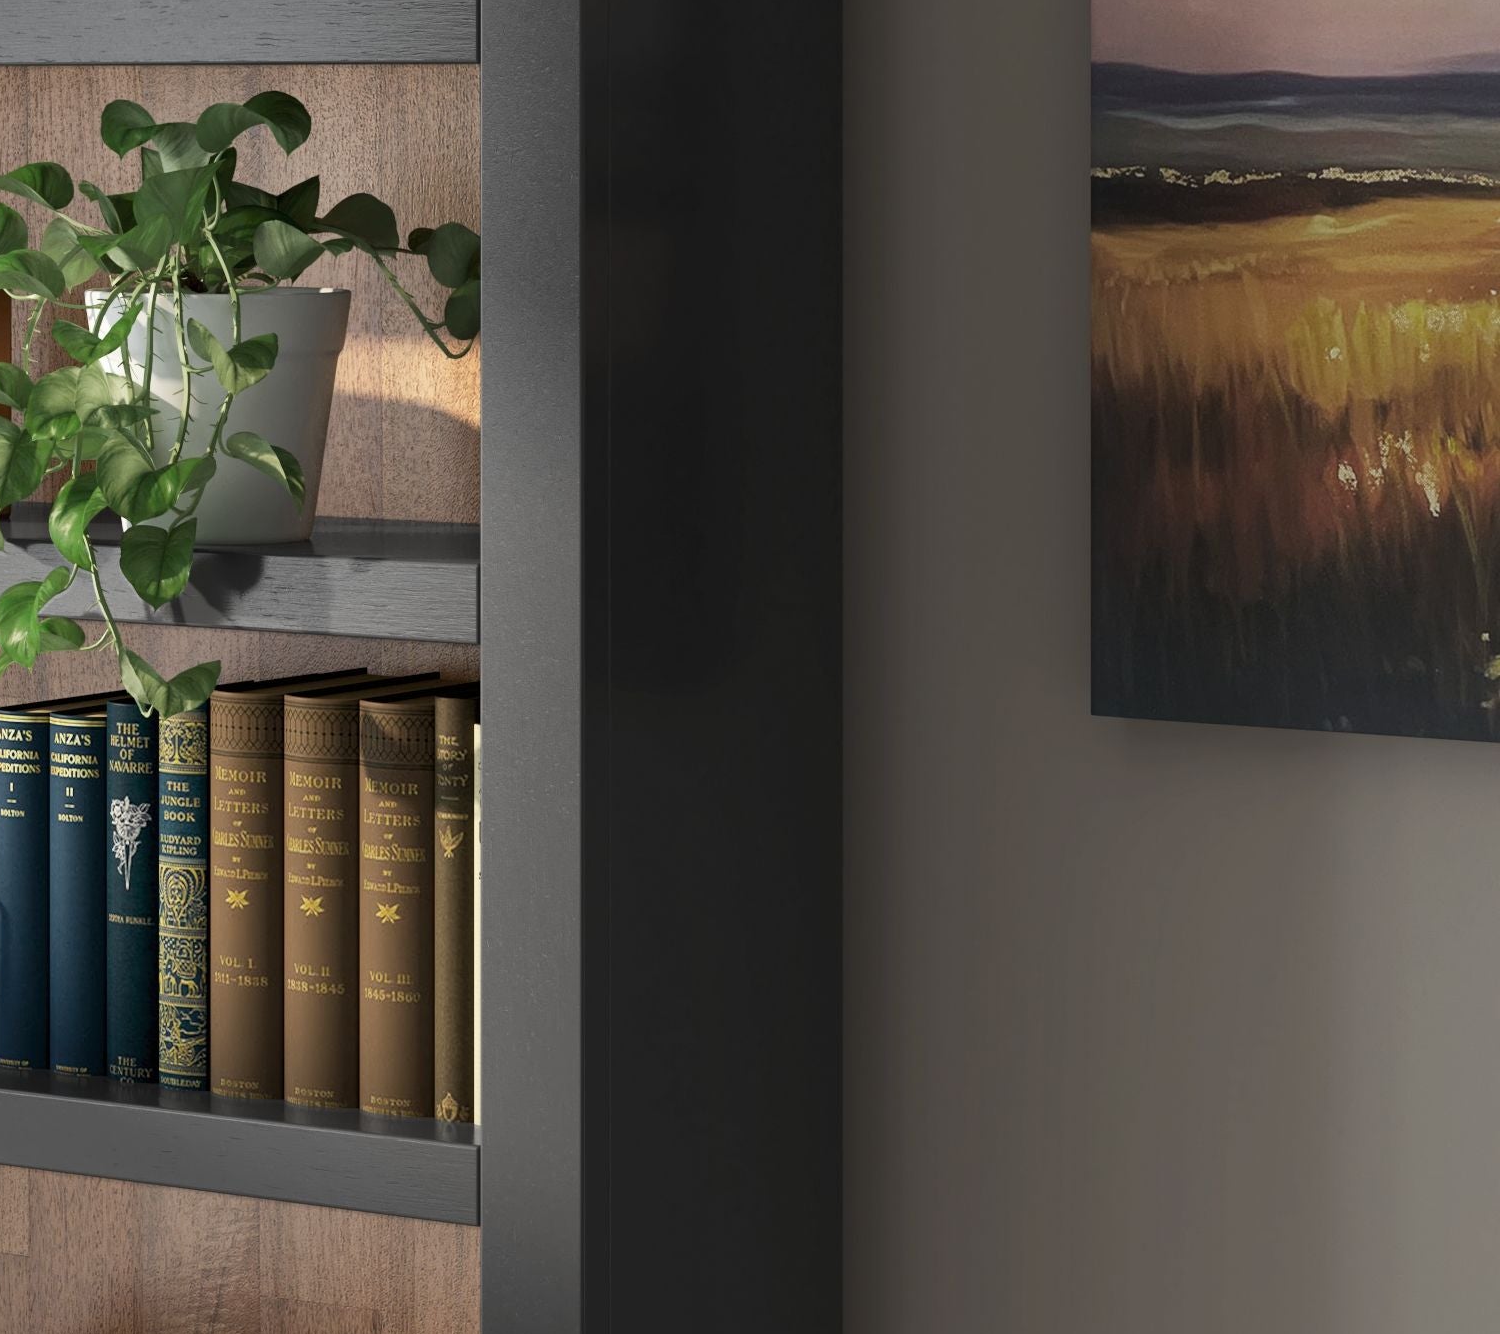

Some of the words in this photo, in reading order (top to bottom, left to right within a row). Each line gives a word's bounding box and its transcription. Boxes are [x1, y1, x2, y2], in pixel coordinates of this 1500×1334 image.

[116, 722, 140, 736] THE
[54, 732, 91, 747] ANZA'S
[110, 735, 150, 749] HELMET
[439, 734, 459, 746] THE
[51, 752, 98, 765] CALIFORNIA
[120, 749, 134, 760] OF
[437, 748, 467, 761] STORY
[50, 765, 100, 779] EXPEDITIONS
[109, 760, 153, 775] NAVARRE
[442, 763, 453, 771] OF
[215, 765, 266, 783] MEMOIR
[289, 771, 342, 789] MEMOIR
[10, 782, 14, 793] I
[66, 787, 73, 797] II
[167, 781, 190, 792] THE
[364, 777, 418, 795] MEMOIR
[160, 795, 200, 808] JUNGLE
[214, 795, 269, 814] LETTERS
[0, 809, 25, 817] BOLTON
[164, 811, 195, 822] BOOK
[288, 802, 345, 820] LETTERS
[58, 814, 84, 823] BOLTON
[364, 808, 421, 827] LETTERS
[160, 833, 202, 845] RUDYARD
[162, 845, 198, 856] KIPLING
[321, 966, 330, 977] II
[397, 974, 411, 985] III
[287, 979, 345, 995] 1838-1845
[364, 987, 421, 1003] 1845-1860
[118, 1056, 137, 1067] THE
[109, 1065, 152, 1078] CENTURY
[220, 1078, 260, 1089] BOSTON
[294, 1087, 334, 1098] BOSTON
[370, 1095, 411, 1107] BOSTON
